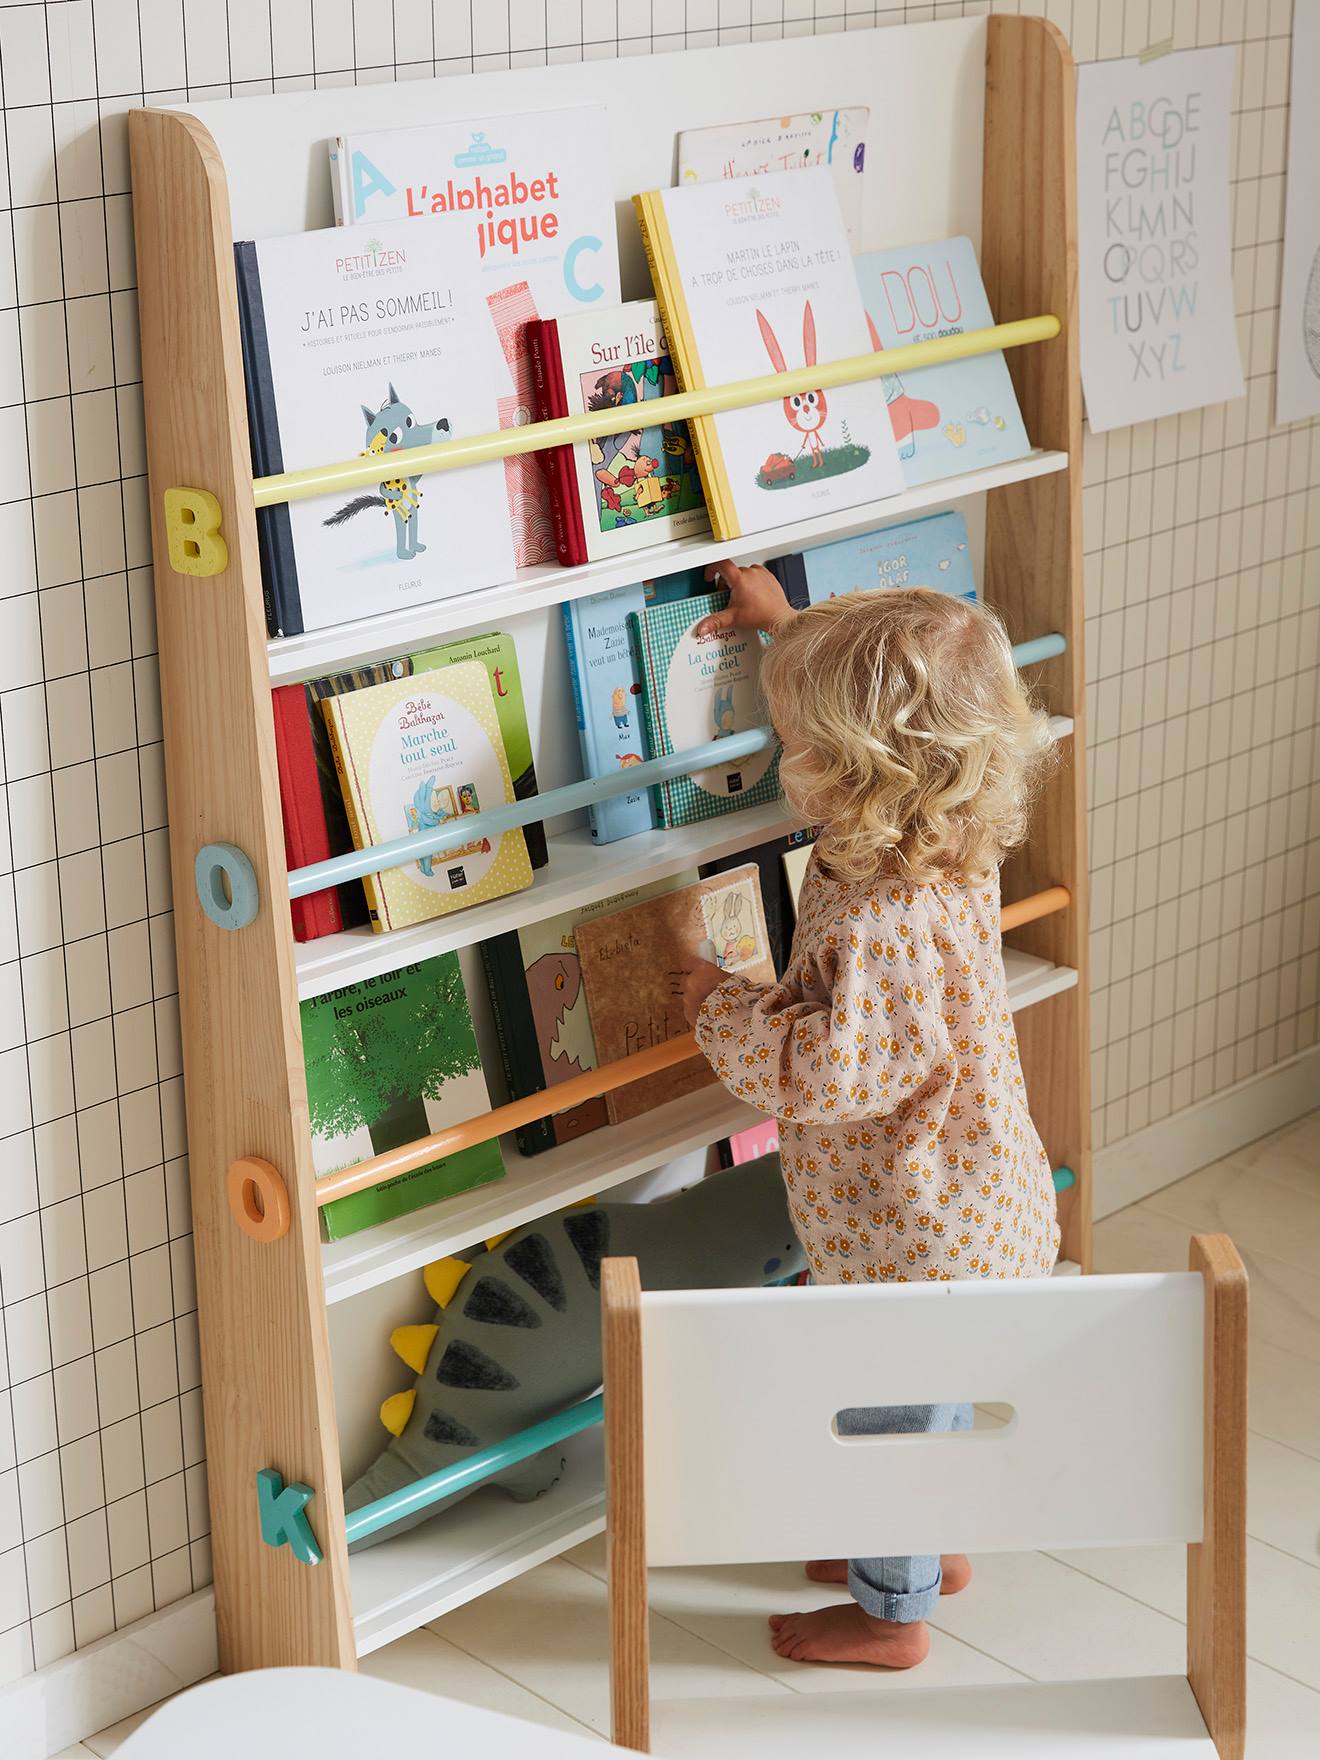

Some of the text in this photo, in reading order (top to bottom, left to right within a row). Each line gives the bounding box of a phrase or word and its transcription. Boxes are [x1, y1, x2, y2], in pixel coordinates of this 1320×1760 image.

[352, 150, 397, 218] A
[406, 172, 559, 217] L'alphabet
[726, 240, 801, 264] MARTIN LE LAPIN
[563, 235, 605, 303] C
[701, 270, 724, 287] TROP
[726, 268, 738, 281] DE
[740, 262, 775, 280] CHOSES
[777, 256, 801, 273] DANS
[802, 256, 814, 268] LA
[880, 260, 962, 335] DOU
[301, 308, 334, 331] J'AI
[341, 303, 369, 325] PAS
[368, 328, 383, 337] POUR
[591, 342, 621, 364] Sur
[625, 333, 655, 358] l'île
[322, 346, 442, 377] LOUISON NIELMAN ET THIERRY MANES
[534, 359, 544, 388] Claude
[877, 555, 908, 575] IGOR
[449, 644, 501, 664] Antonin Louchard
[604, 637, 625, 650] Zazie
[688, 642, 748, 665] La couleur
[588, 654, 606, 668] veut
[606, 652, 617, 664] un
[701, 656, 740, 676] du ciel
[405, 698, 431, 715] Bébé
[398, 712, 445, 729] Balthazar
[401, 728, 448, 749] Marche
[400, 738, 457, 765] tout seul
[788, 831, 803, 846] Le
[364, 978, 377, 990] le
[380, 969, 402, 985] loir
[406, 962, 422, 975] et
[334, 987, 408, 1020] les oiseaux
